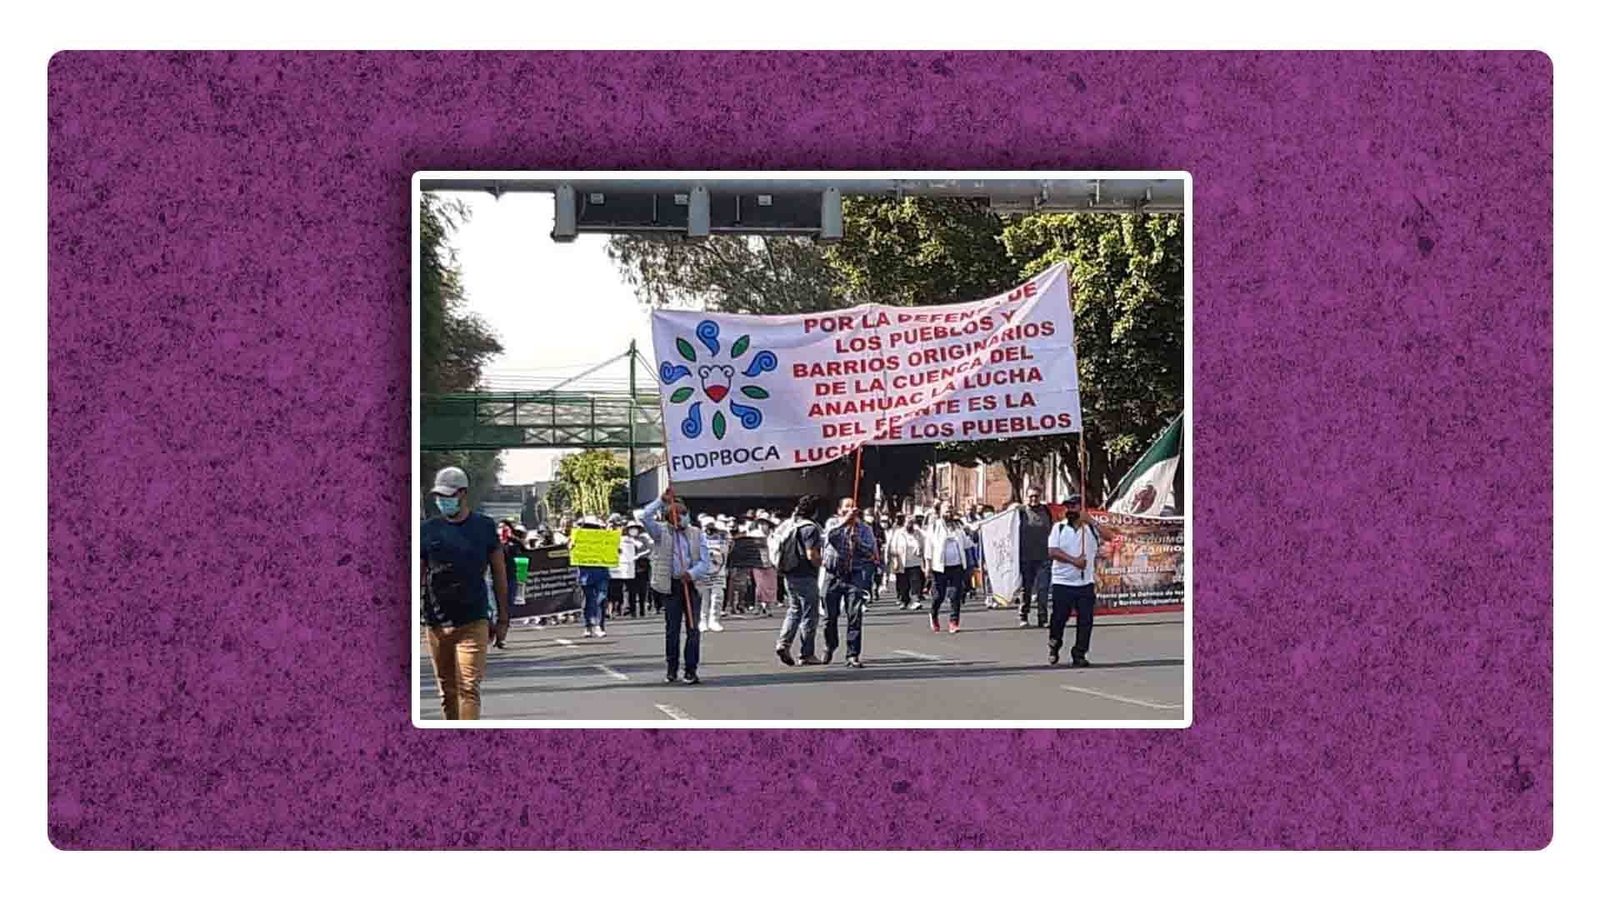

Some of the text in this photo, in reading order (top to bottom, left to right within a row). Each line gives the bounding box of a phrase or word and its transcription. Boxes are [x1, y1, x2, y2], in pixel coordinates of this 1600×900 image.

[804, 316, 854, 333] POR
[862, 312, 891, 328] LA
[836, 309, 1017, 353] LOS PUEBLOS Y
[793, 321, 1055, 378] BARRIOS ORIGINARIOS
[815, 345, 1034, 396] DE LA CUENCA DEL
[808, 366, 1044, 417] ANAHUAC LA LUCHA
[822, 421, 867, 438] DEL
[968, 394, 998, 413] ES
[1005, 391, 1037, 409] LA
[672, 445, 780, 472] FDDPBOCA
[794, 443, 856, 463] LUCH
[910, 422, 955, 438] LOS
[962, 413, 1072, 436] PUEBLOS
